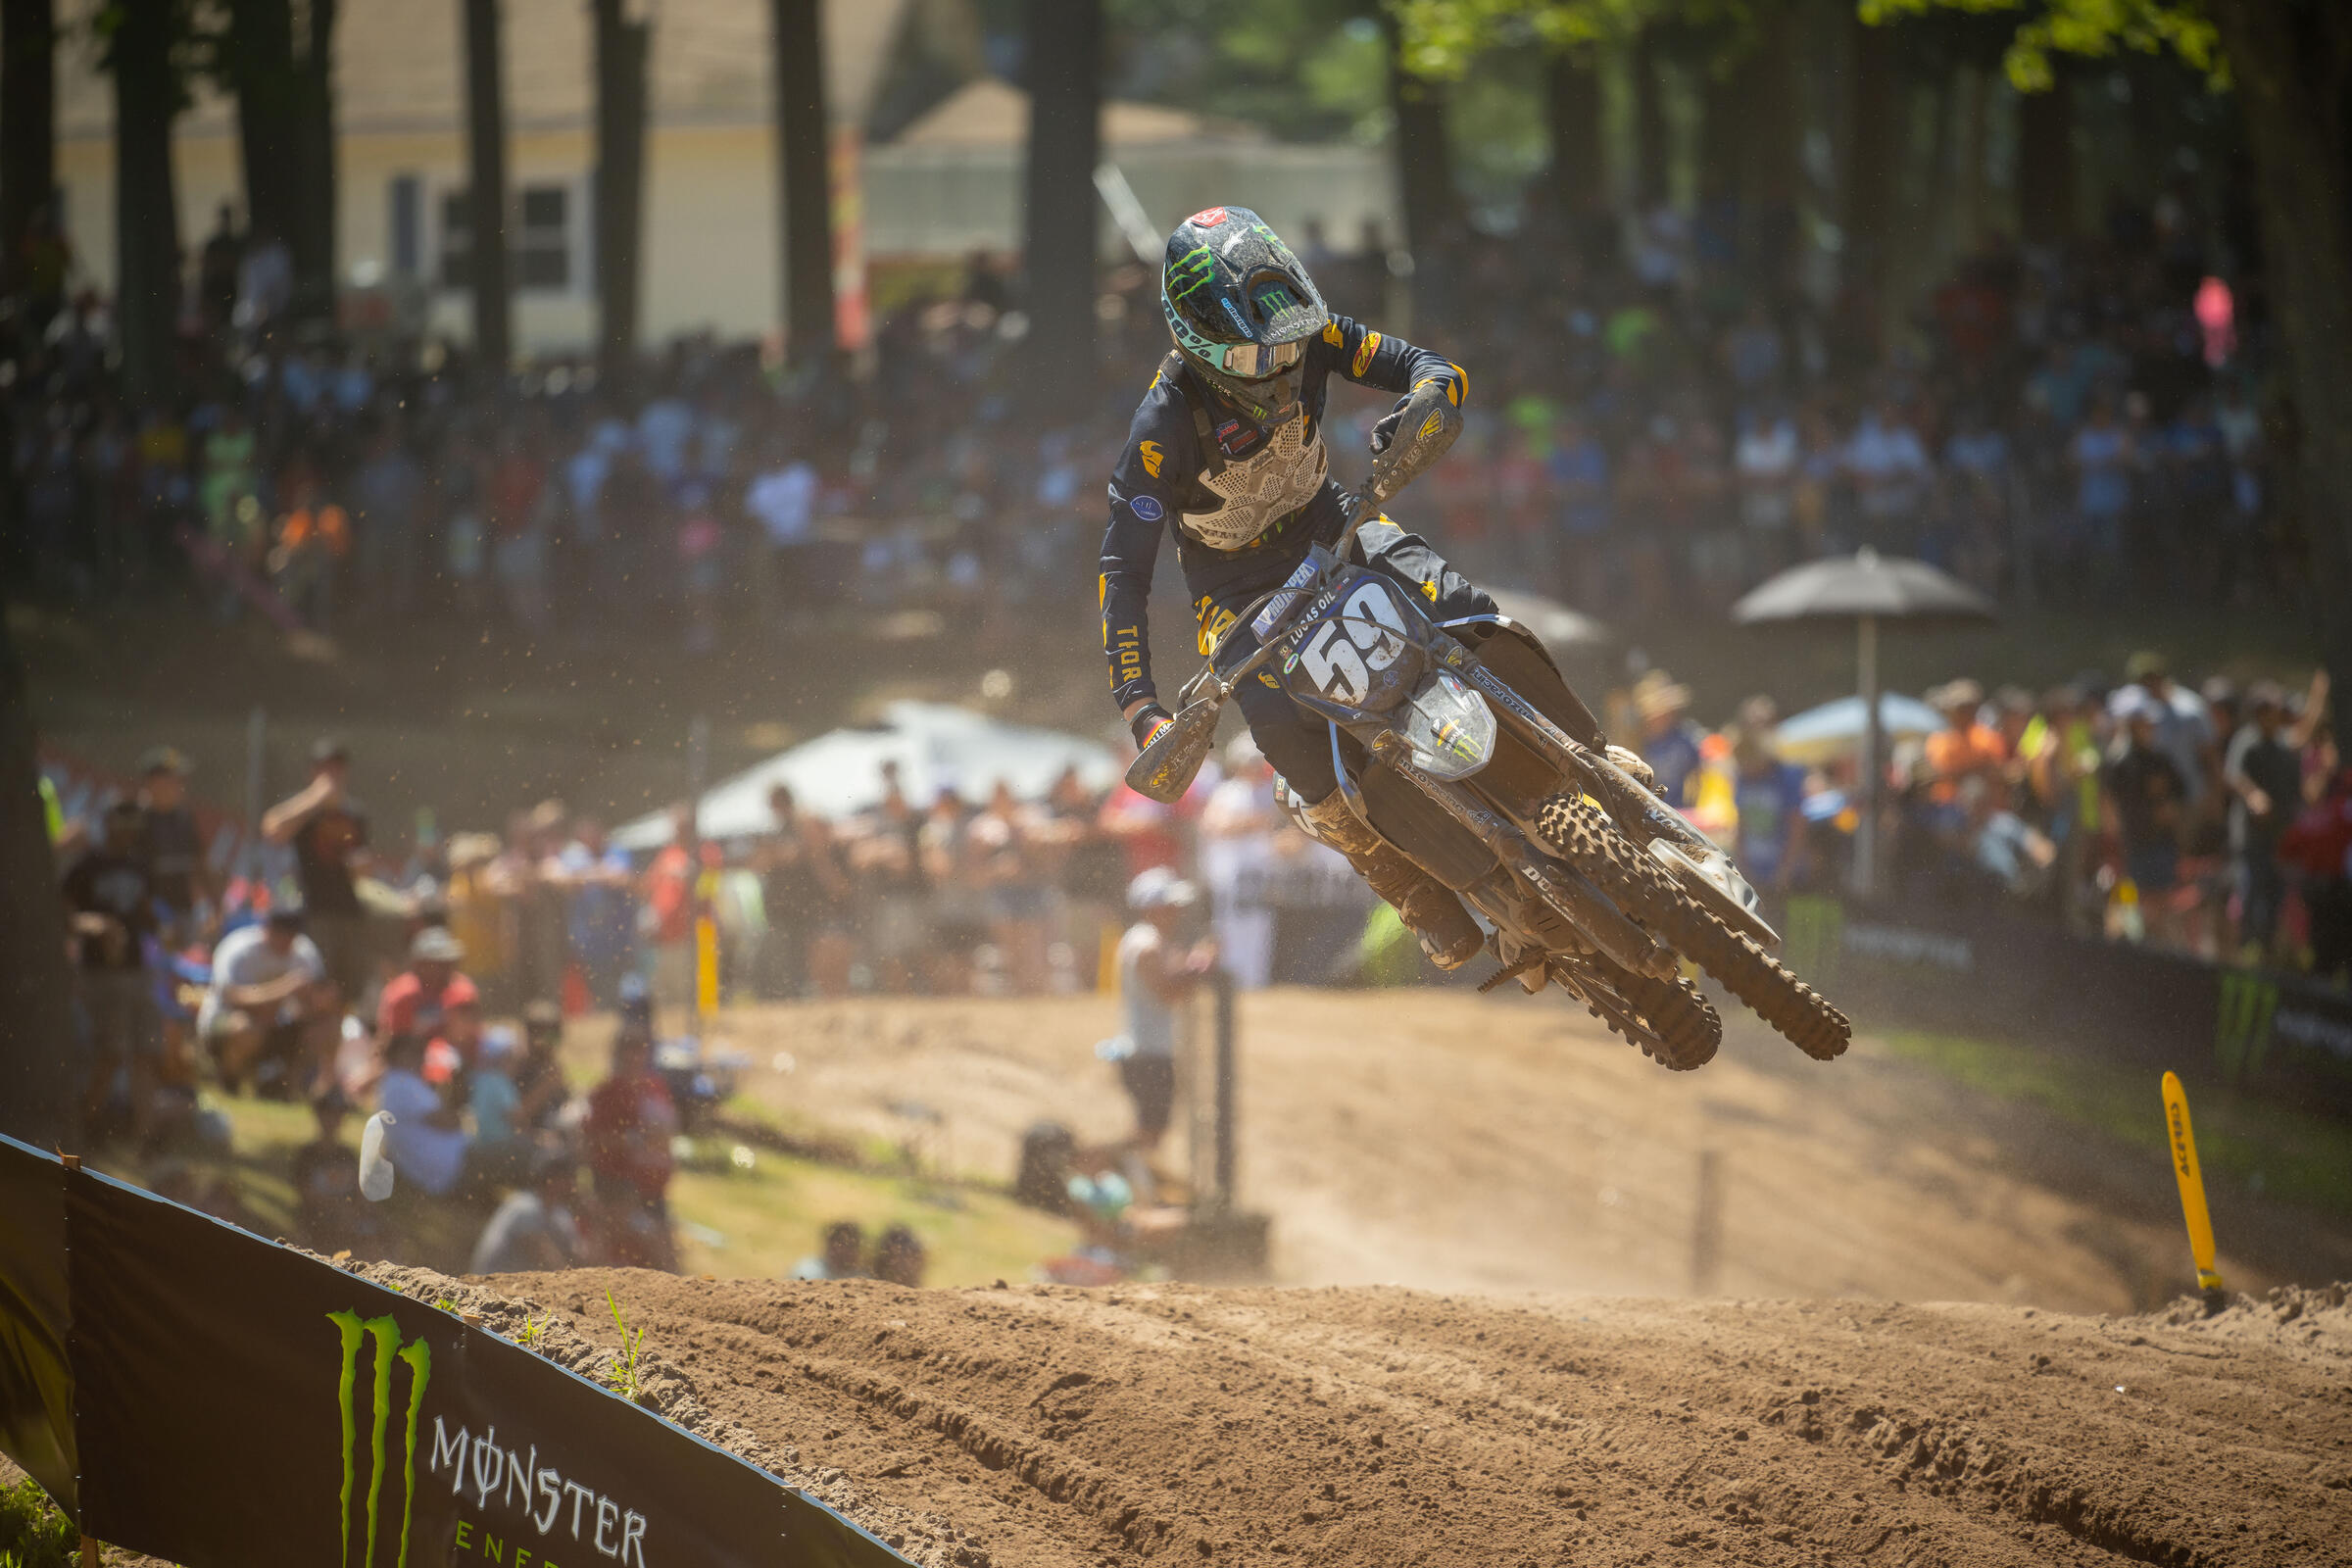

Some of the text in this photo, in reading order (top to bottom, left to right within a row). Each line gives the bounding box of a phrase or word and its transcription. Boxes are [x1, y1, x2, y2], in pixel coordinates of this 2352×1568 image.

[1162, 298, 1212, 359] 00%
[1289, 606, 1319, 646] LUCAS
[1317, 590, 1337, 611] OIL
[1299, 582, 1408, 706] 59
[431, 1415, 648, 1568] MONSTER
[455, 1520, 560, 1568] ENE
